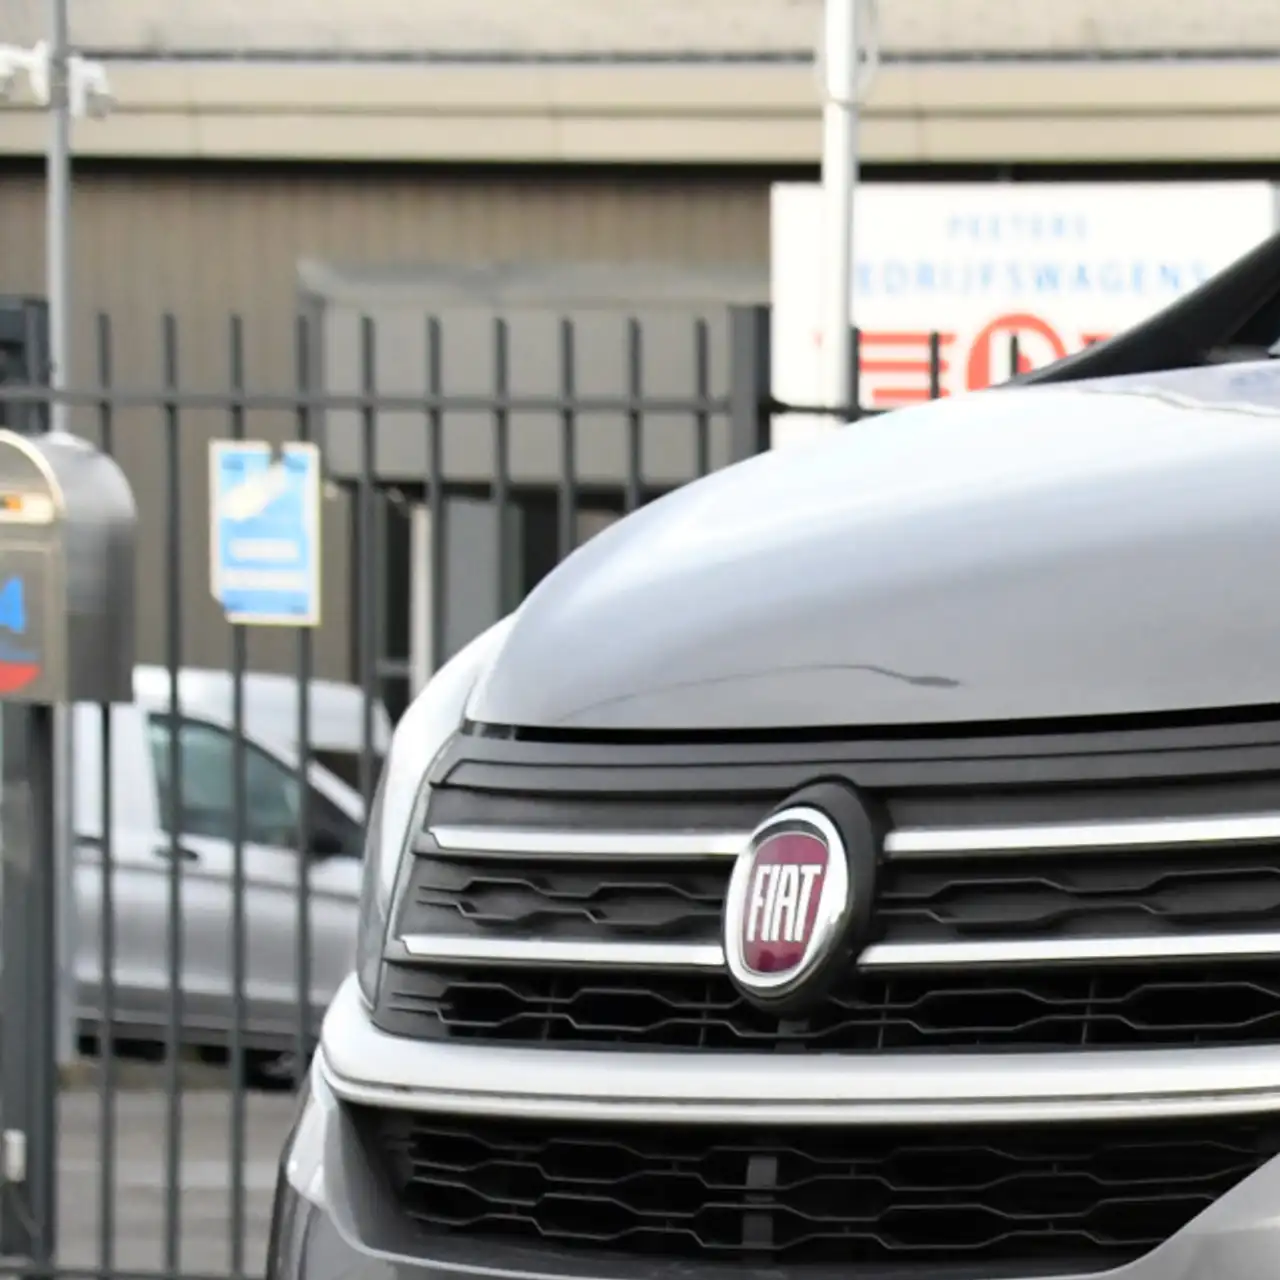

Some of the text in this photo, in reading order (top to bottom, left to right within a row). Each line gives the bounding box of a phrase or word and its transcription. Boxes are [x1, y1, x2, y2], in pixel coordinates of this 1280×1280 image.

[946, 212, 1089, 239] PEETERS
[855, 259, 1213, 295] EDRIJFSWAGENS
[746, 864, 822, 942] FIAT
